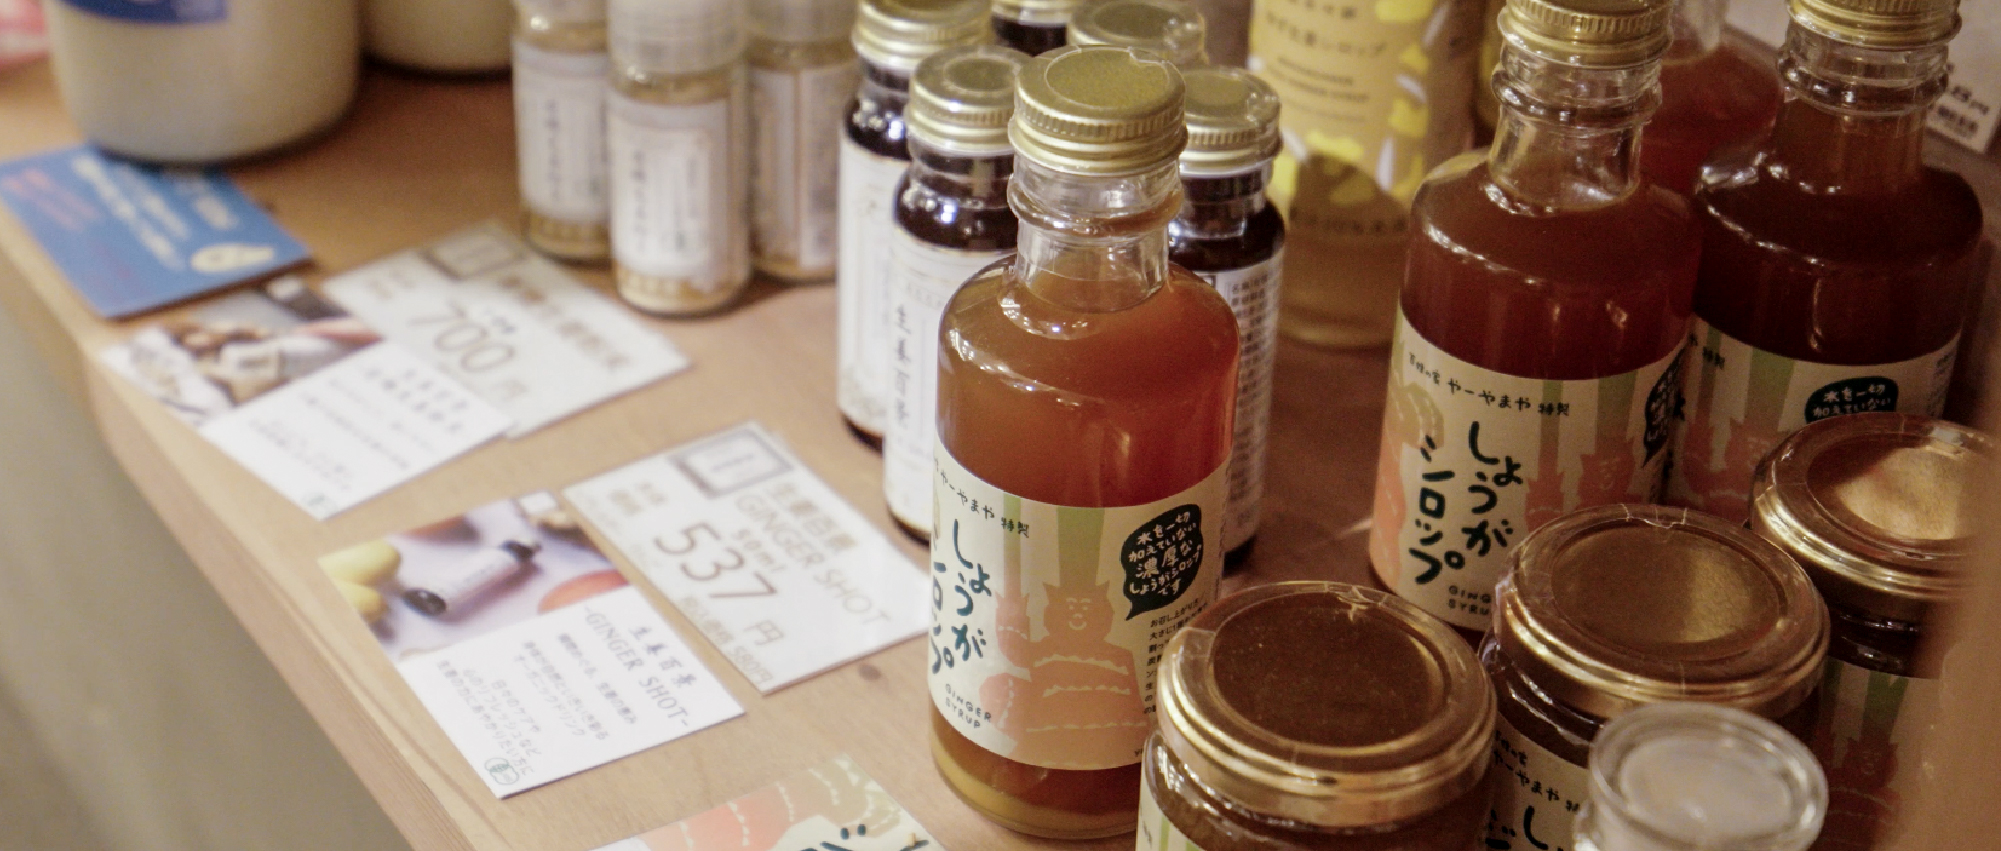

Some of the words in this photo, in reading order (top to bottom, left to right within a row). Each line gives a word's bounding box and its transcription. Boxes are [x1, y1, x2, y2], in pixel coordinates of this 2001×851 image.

[407, 303, 517, 374] 700
[1449, 378, 1531, 412] やーやまや
[1537, 402, 1570, 417] 特製
[1823, 384, 1886, 403] 水を一切
[1408, 434, 1465, 585] シロップ
[1462, 420, 1523, 557] しょうが
[1129, 522, 1197, 562] 加えていない
[1137, 511, 1190, 545] 水を一切
[654, 521, 778, 601] 537
[744, 618, 786, 647] 円
[735, 493, 826, 570] GINGER
[814, 565, 892, 627] SHOT
[1129, 544, 1202, 594] しょうがシロップ
[1135, 540, 1193, 579] 濃厚な
[951, 518, 992, 662] しょうが
[627, 624, 698, 688] 生姜百景
[945, 683, 991, 722] GINGER
